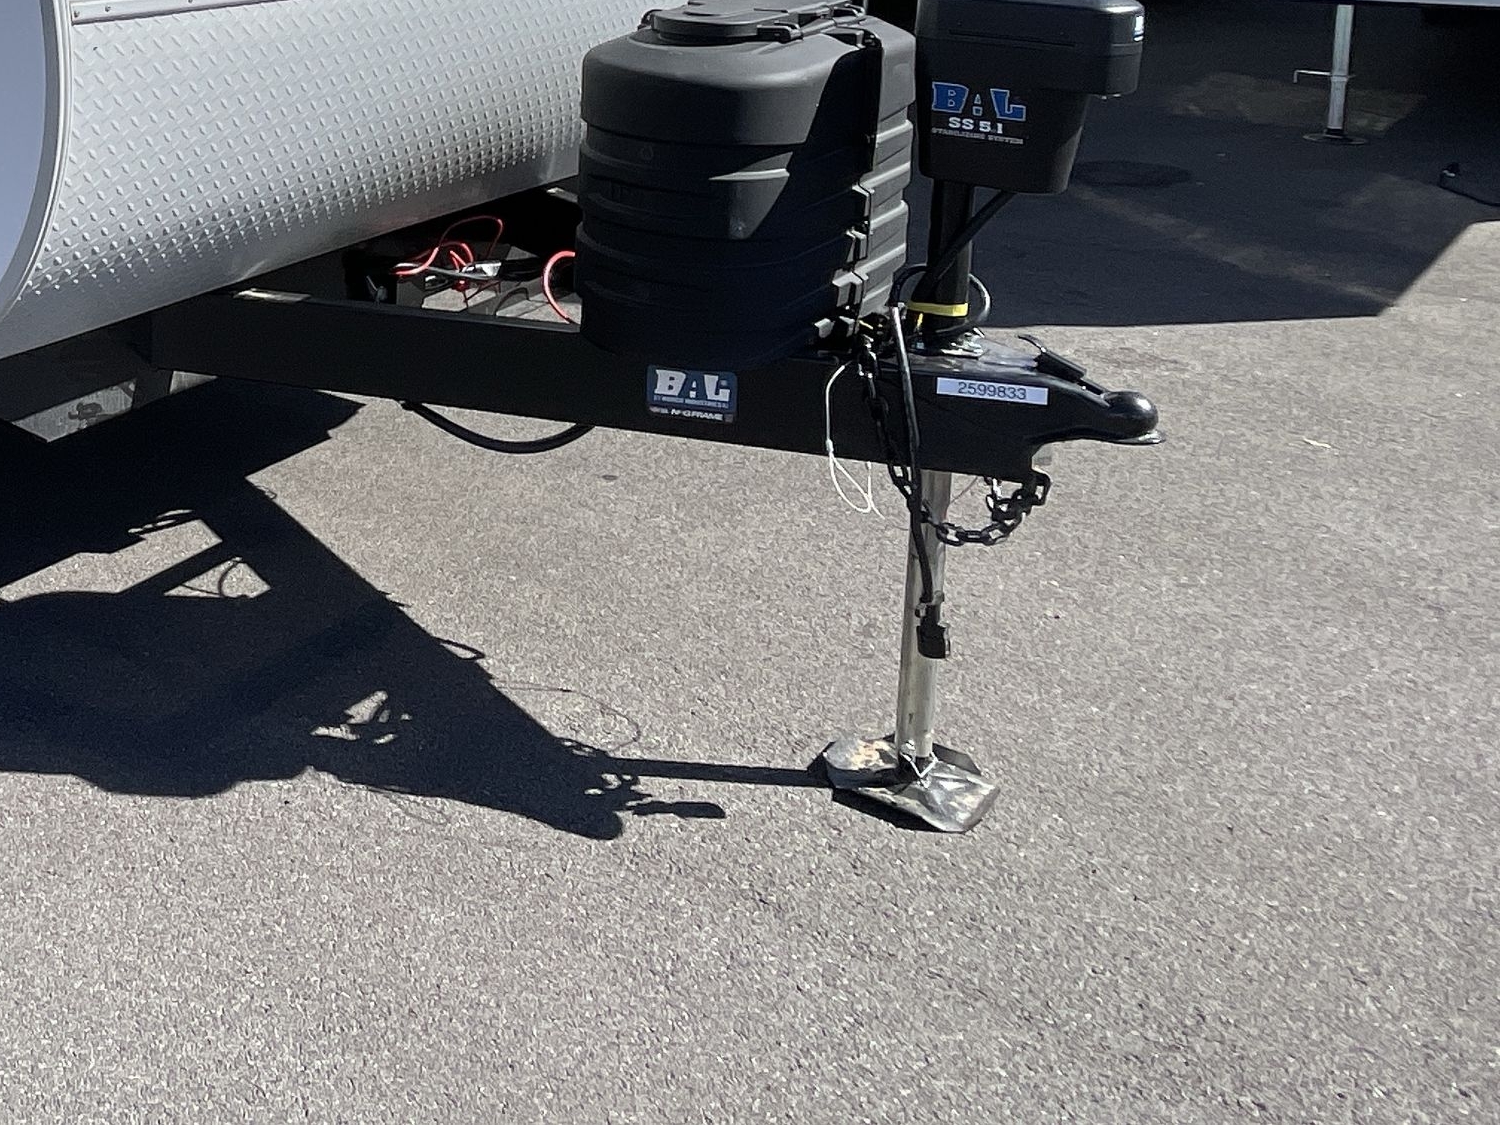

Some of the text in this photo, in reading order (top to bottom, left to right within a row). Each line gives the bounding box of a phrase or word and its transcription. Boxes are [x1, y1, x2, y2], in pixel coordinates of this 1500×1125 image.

[931, 81, 1026, 122] BAL
[948, 116, 975, 130] SS
[654, 369, 731, 402] BAL
[958, 381, 1027, 400] 2599833
